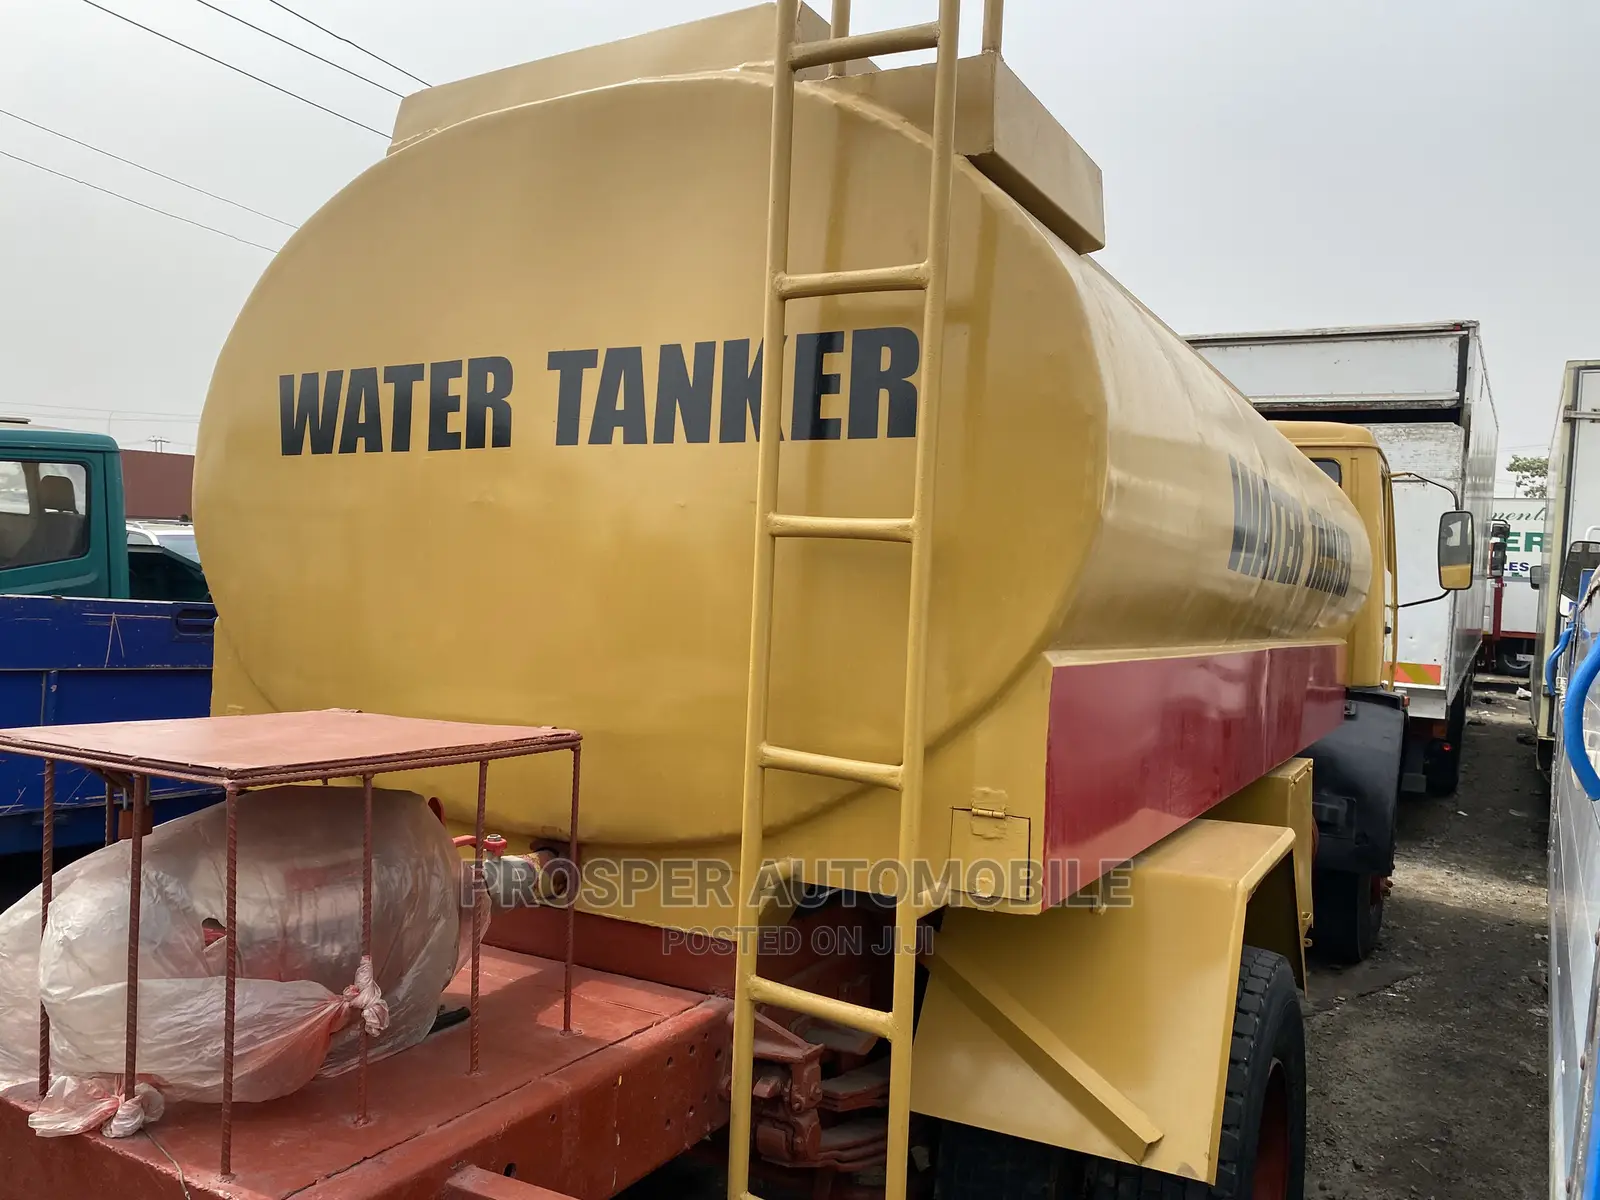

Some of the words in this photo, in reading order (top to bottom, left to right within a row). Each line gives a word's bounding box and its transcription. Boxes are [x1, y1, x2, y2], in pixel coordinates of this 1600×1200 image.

[279, 355, 514, 456] WATER
[547, 326, 920, 446] TANKER
[1227, 453, 1304, 586] WATER
